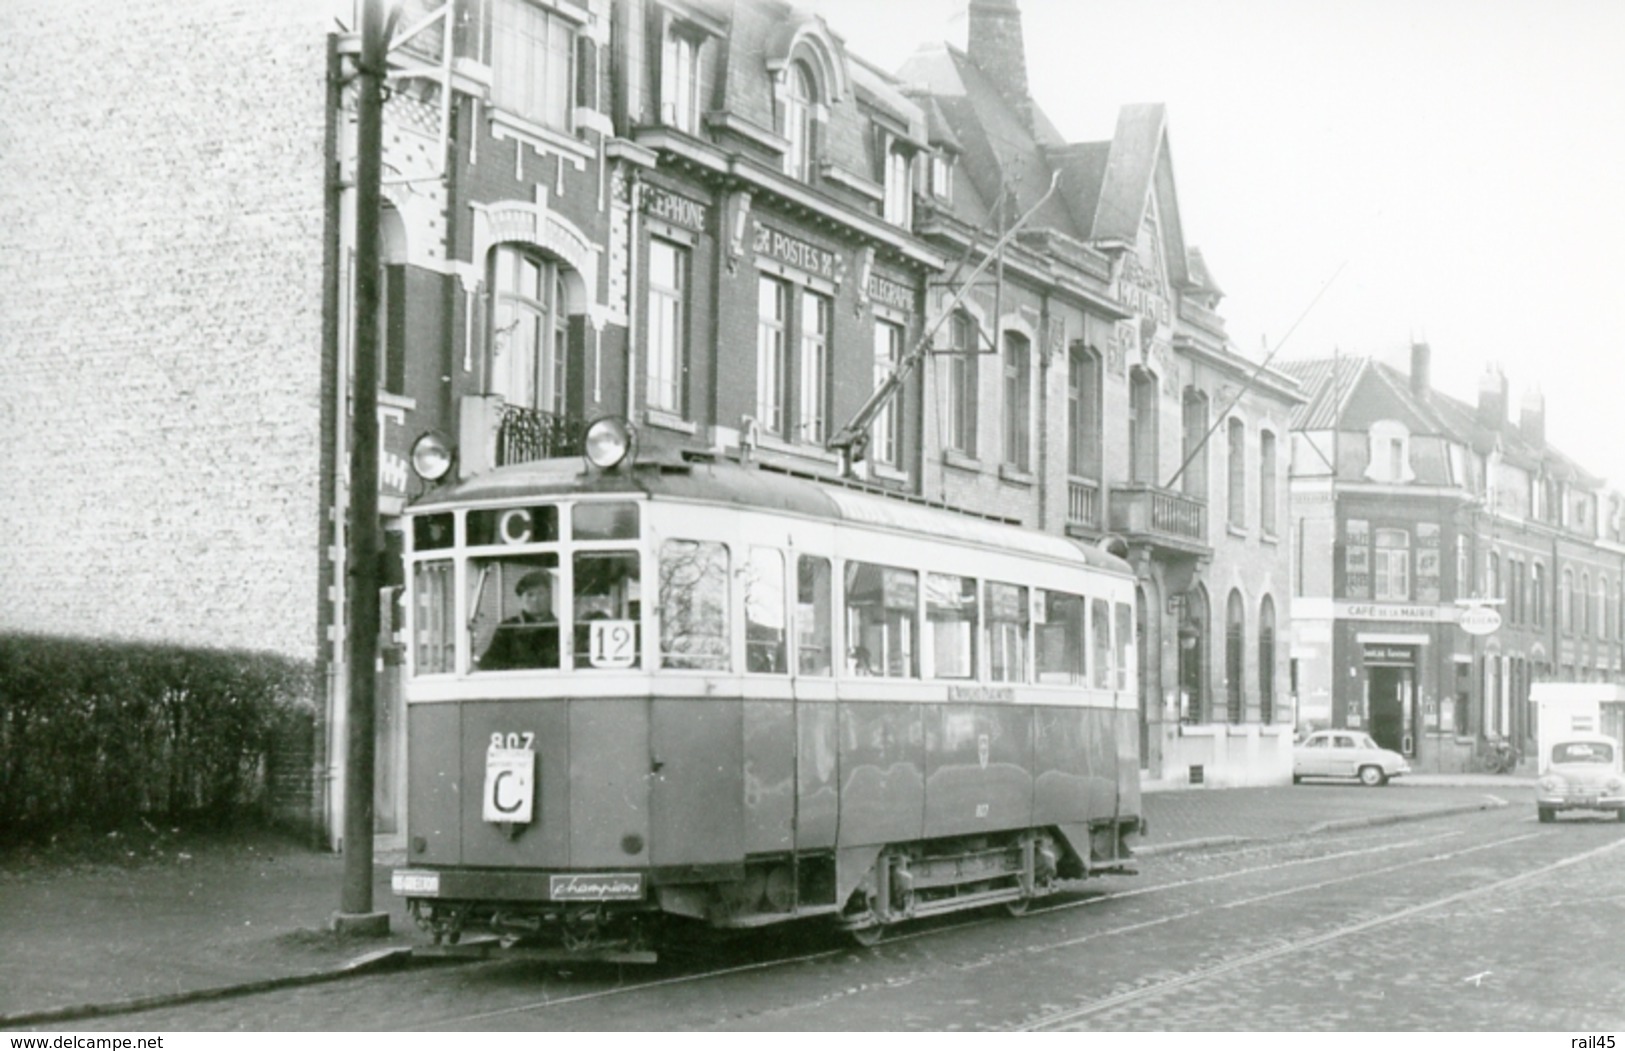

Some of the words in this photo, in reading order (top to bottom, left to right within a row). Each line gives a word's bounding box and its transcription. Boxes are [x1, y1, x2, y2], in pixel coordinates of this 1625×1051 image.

[773, 231, 819, 272] POSTES
[501, 508, 531, 545] C
[1400, 606, 1435, 618] MAIRIE
[595, 626, 631, 662] 12
[490, 731, 535, 750] 807
[493, 770, 523, 814] C
